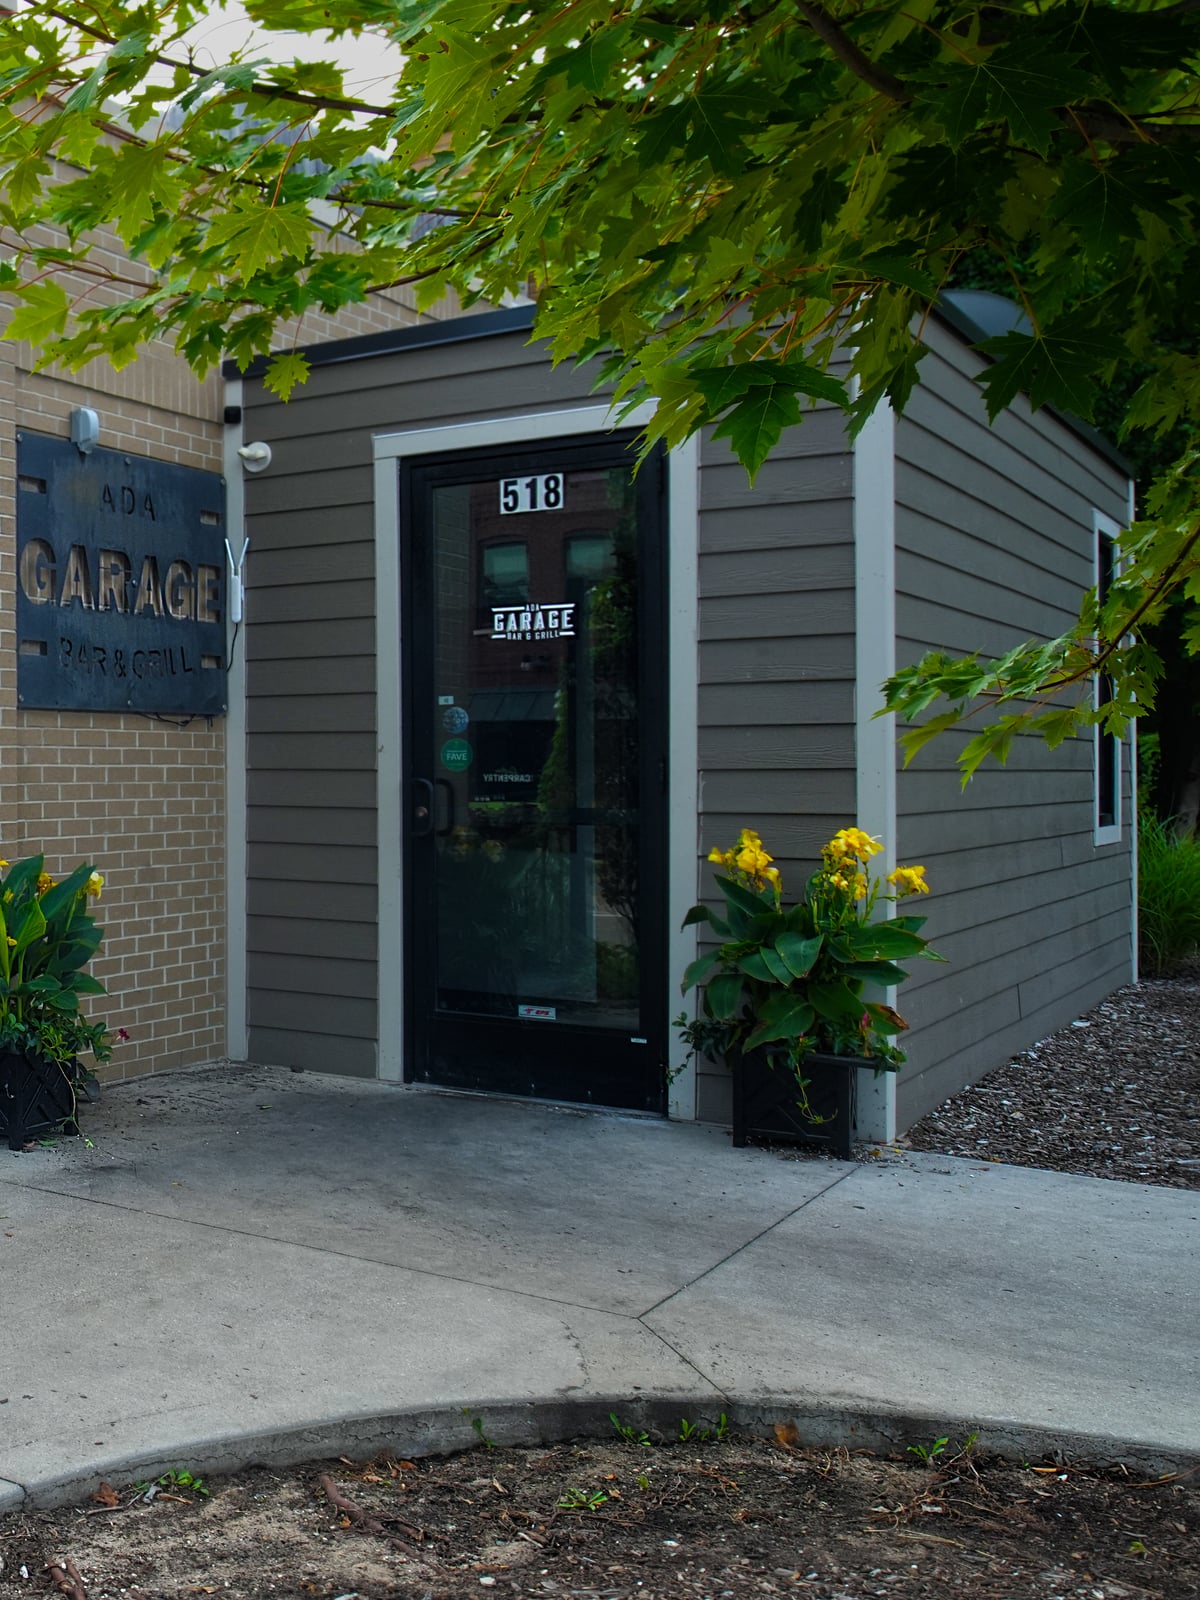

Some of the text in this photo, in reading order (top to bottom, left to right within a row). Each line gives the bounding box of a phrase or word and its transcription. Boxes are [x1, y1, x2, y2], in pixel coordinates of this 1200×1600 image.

[100, 483, 156, 521] ADA
[502, 475, 561, 513] 518
[20, 537, 222, 624] GARAGE
[494, 609, 574, 632] GARAGE
[507, 632, 522, 641] BAR
[535, 630, 559, 640] GRILL
